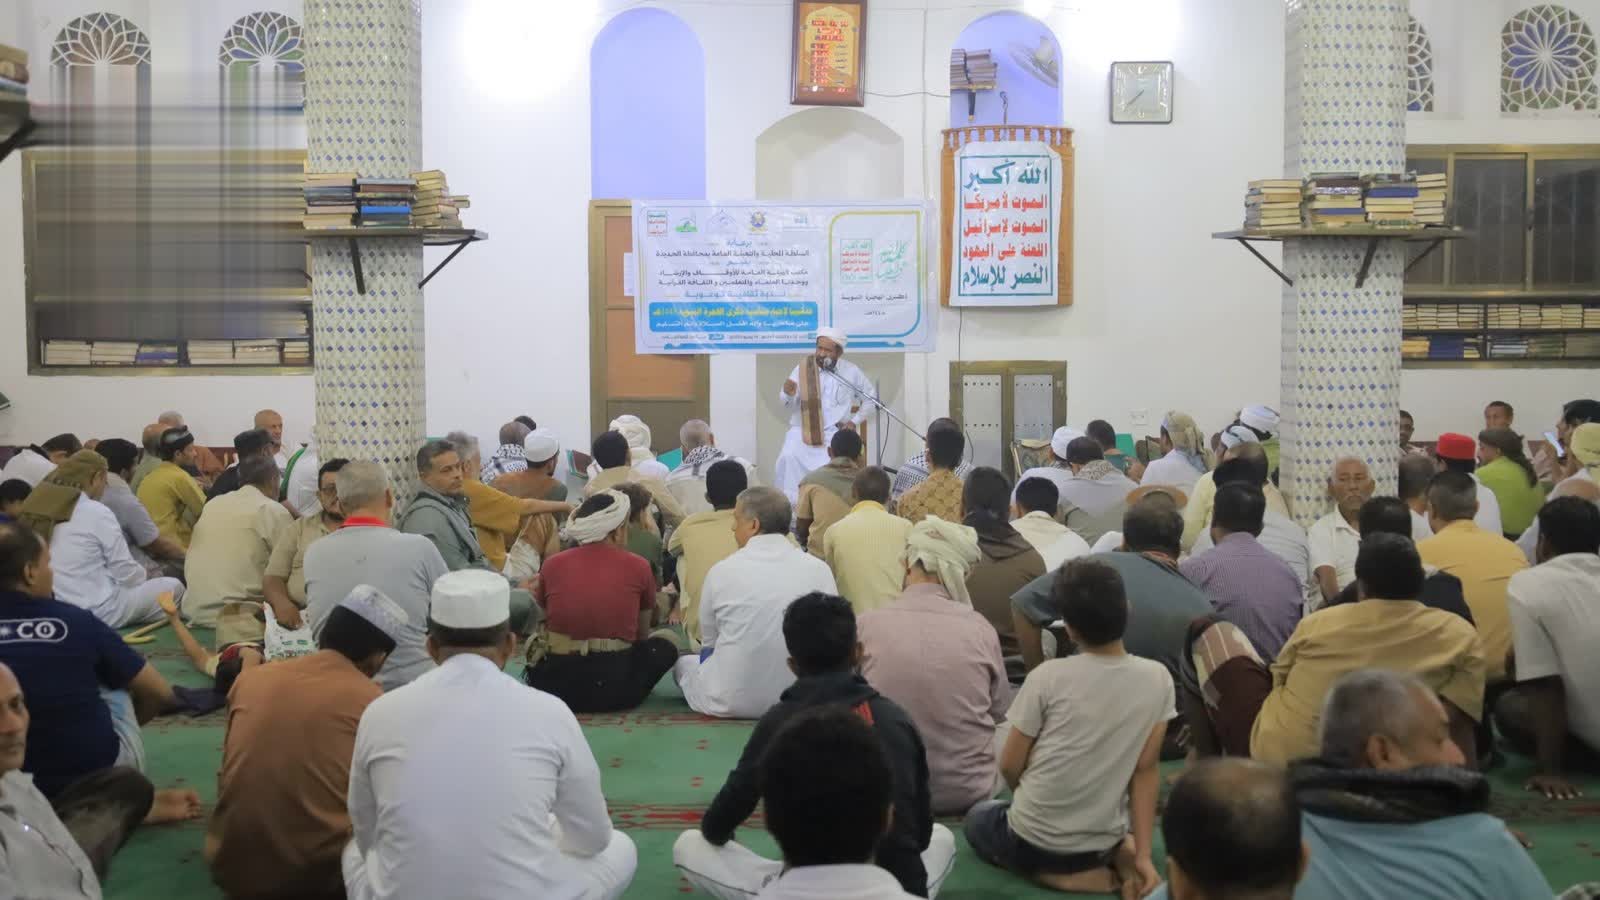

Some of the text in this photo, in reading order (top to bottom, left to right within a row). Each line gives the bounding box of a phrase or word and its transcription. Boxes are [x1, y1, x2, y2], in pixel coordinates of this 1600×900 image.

[963, 159, 1047, 192] الله أكبر
[964, 191, 1047, 213] الموت لأمريكا
[964, 218, 1047, 237] الموت لإسرائيل
[963, 242, 1047, 261] اللعنة على اليهود
[963, 263, 1048, 291] النصر للإسلام
